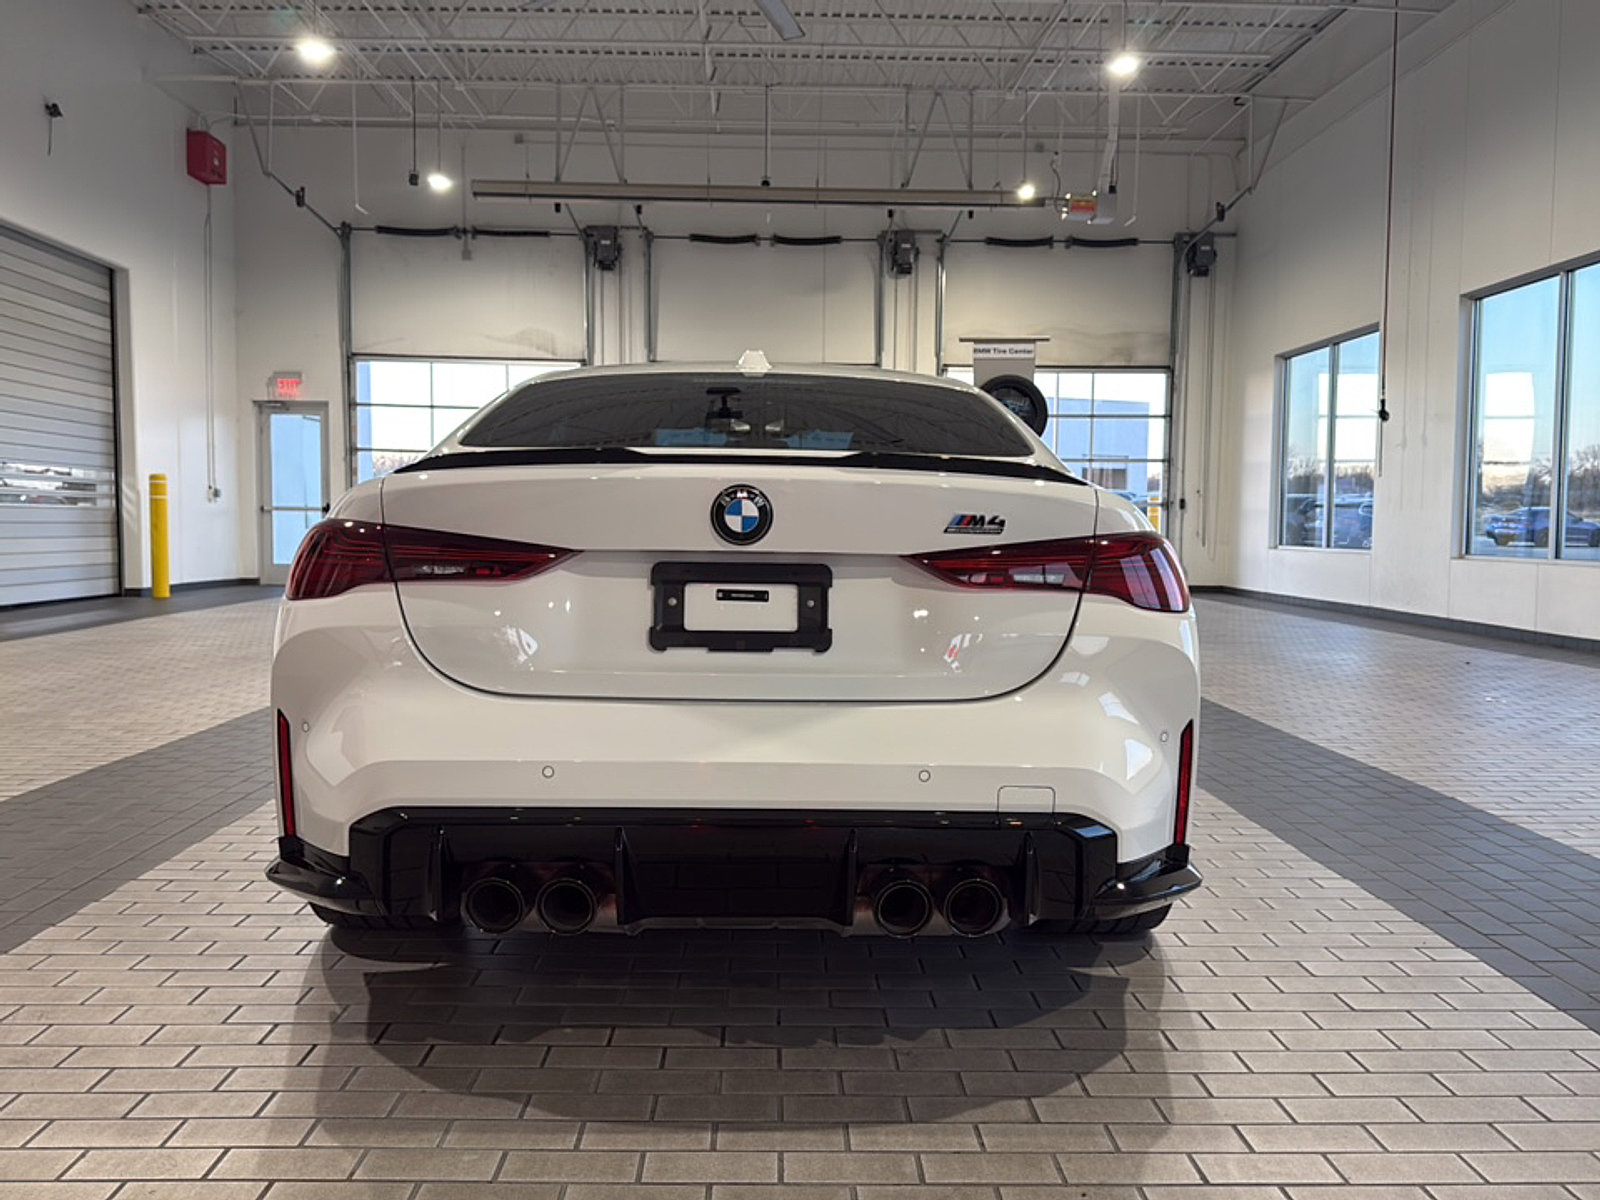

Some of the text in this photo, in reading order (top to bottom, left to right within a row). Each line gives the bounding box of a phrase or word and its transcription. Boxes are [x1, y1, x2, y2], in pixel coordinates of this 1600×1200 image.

[973, 346, 1034, 355] BMW Tire Center
[719, 489, 767, 507] BMW
[961, 514, 1006, 528] M4
